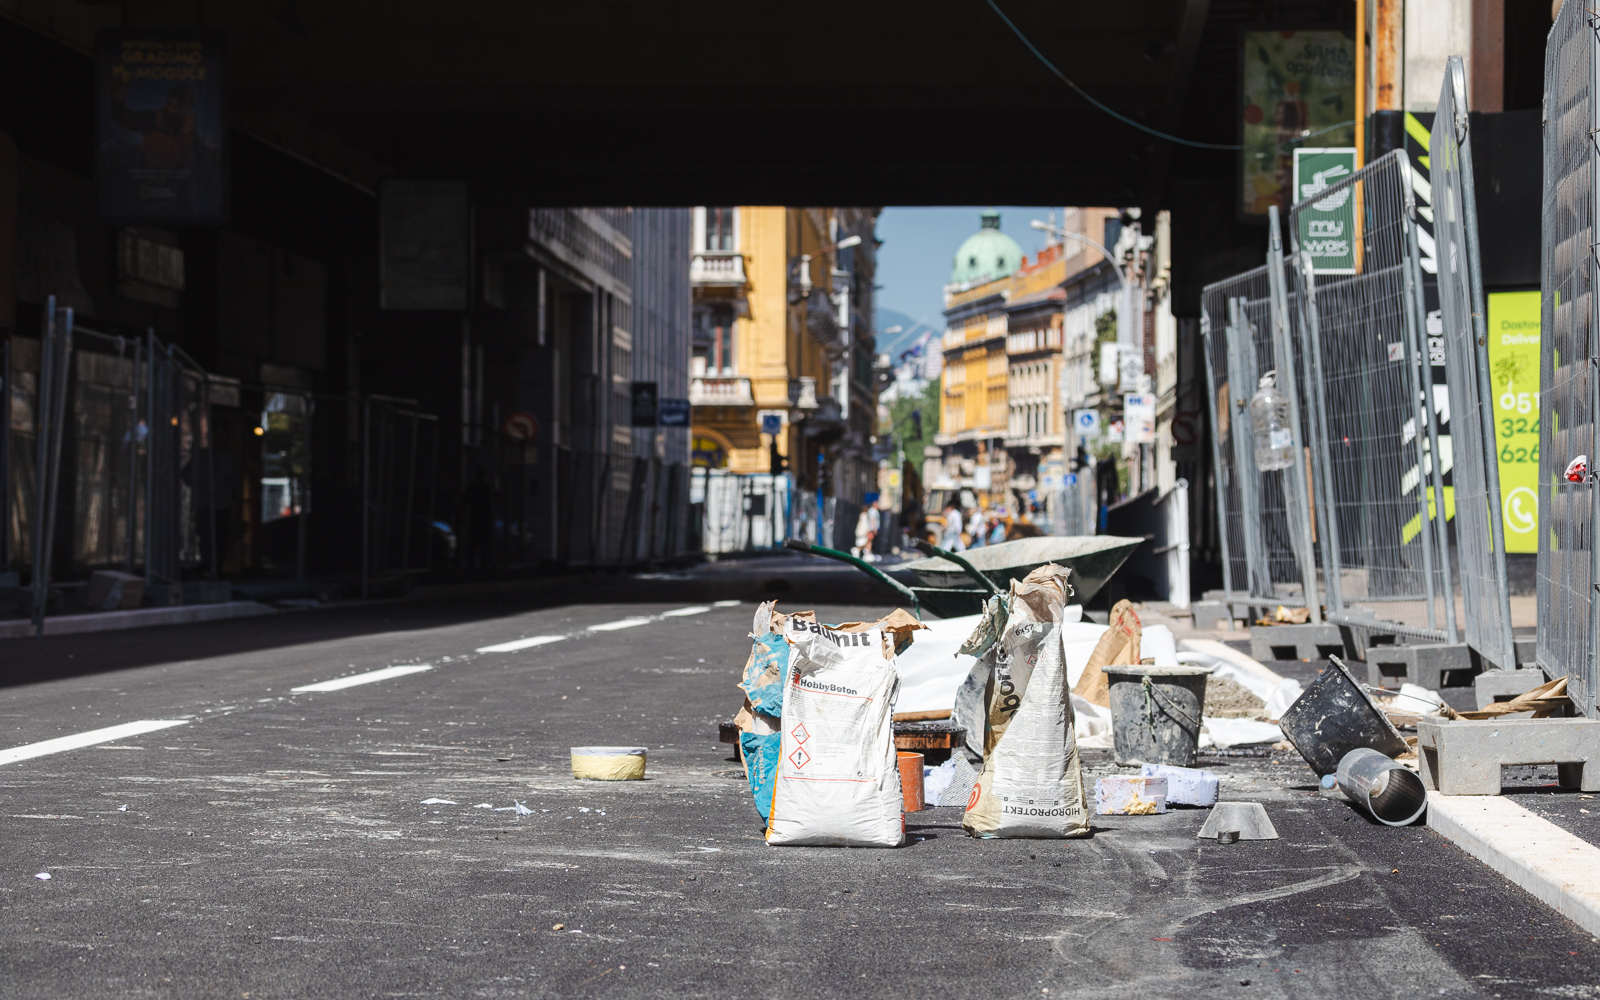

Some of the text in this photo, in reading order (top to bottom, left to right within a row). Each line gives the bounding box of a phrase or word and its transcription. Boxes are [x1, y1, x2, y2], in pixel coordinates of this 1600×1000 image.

[122, 51, 201, 64] GRADIMO
[1499, 392, 1540, 415] 051
[1500, 444, 1540, 463] 626
[792, 619, 871, 648] Baumit
[800, 679, 858, 695] HobbyBeton
[1002, 805, 1081, 817] HIDROPROTEKT
